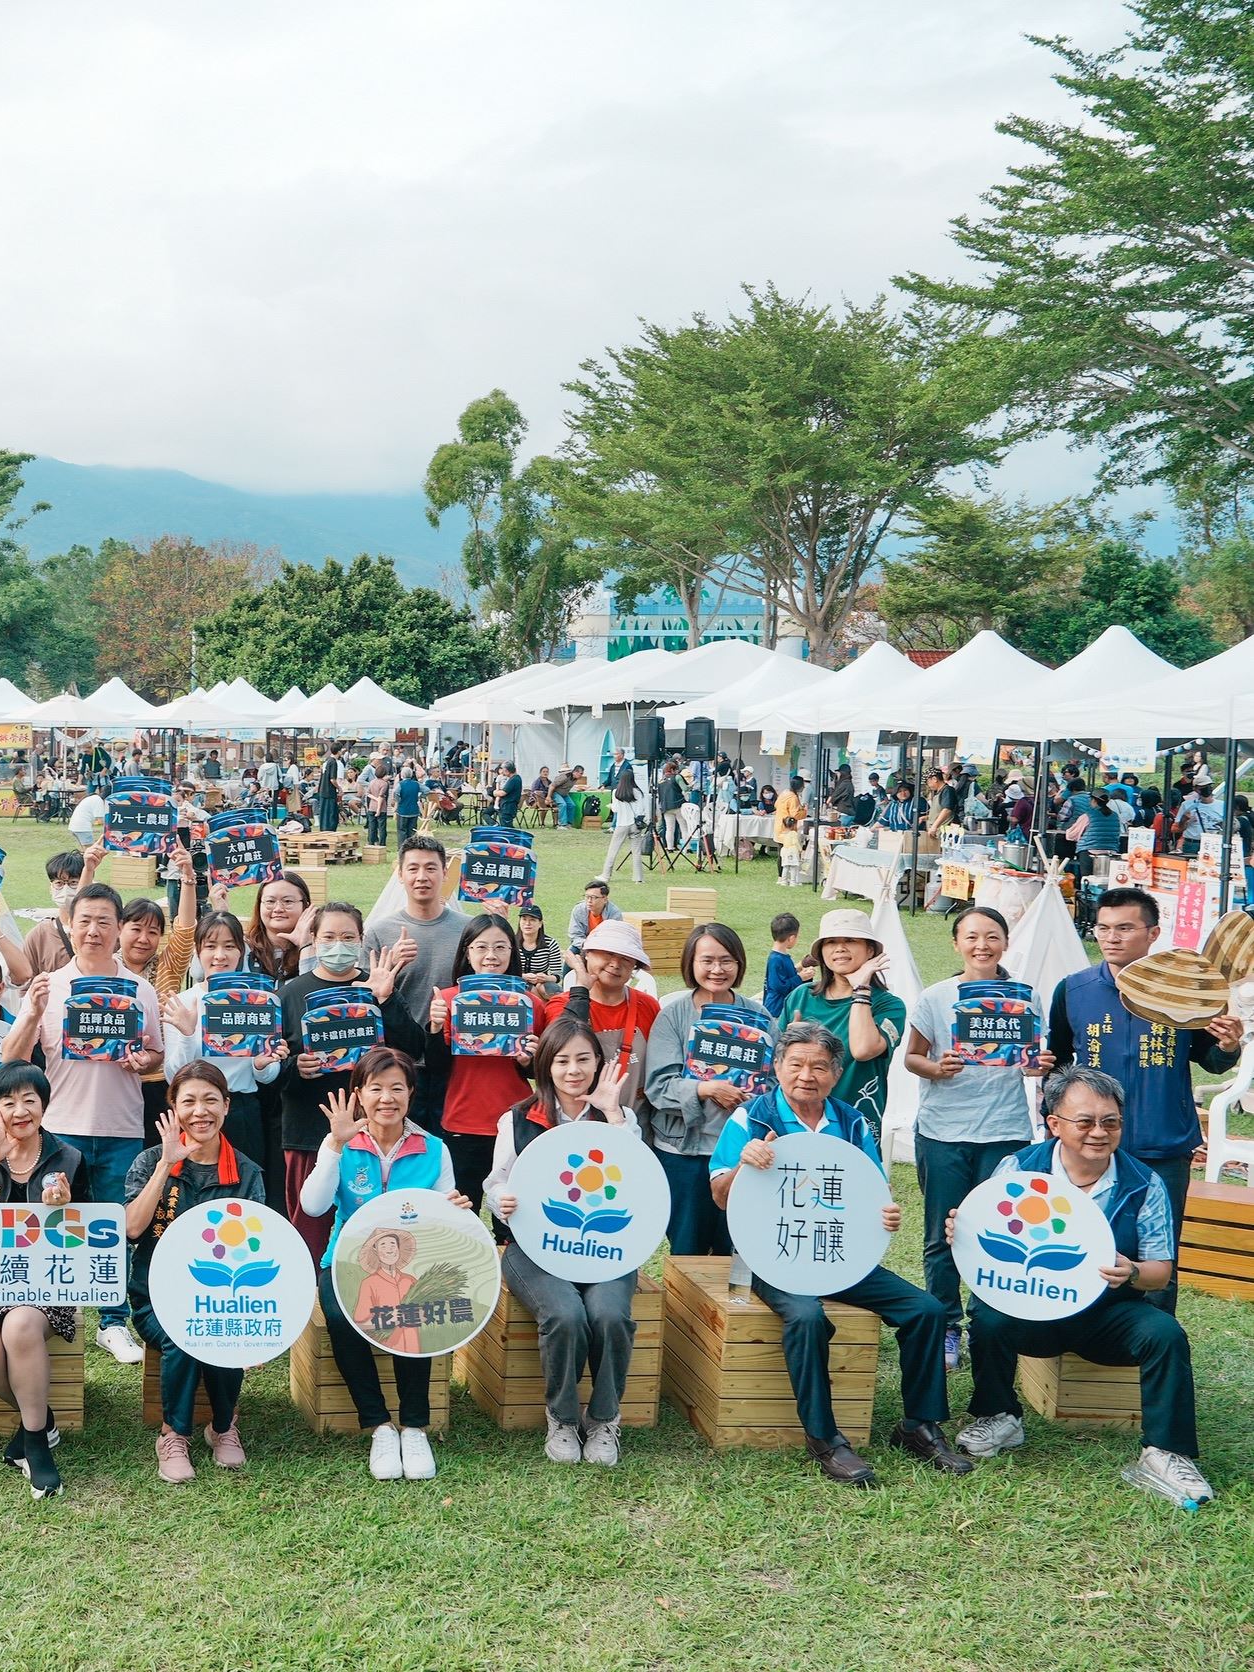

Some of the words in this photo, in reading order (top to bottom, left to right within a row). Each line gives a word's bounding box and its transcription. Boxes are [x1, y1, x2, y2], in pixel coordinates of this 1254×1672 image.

[112, 811, 170, 826] 九一七農場
[228, 840, 256, 853] 太魯閣
[225, 852, 263, 865] 767農莊
[471, 861, 525, 880] 金品醬園
[209, 1012, 272, 1026] 一品醇商號
[463, 1012, 520, 1027] 新味貿易
[969, 1017, 1021, 1031] 美好食代
[1102, 1013, 1114, 1034] 主任
[79, 1025, 126, 1035] 股份有限公司
[969, 1030, 1021, 1040] 股份有限公司
[699, 1039, 759, 1064] 無思農莊
[777, 1163, 845, 1210] 花蓮
[542, 1232, 623, 1262] Hualien
[776, 1216, 845, 1263] 好釀
[976, 1268, 1078, 1304] Hualien
[58, 1287, 119, 1303] Hualien
[195, 1295, 277, 1313] Hualien
[370, 1298, 475, 1331] 花蓮好農
[186, 1318, 282, 1337] 花蓮縣政府
[185, 1340, 212, 1348] Hualien
[217, 1340, 240, 1349] County
[243, 1340, 284, 1348] Government
